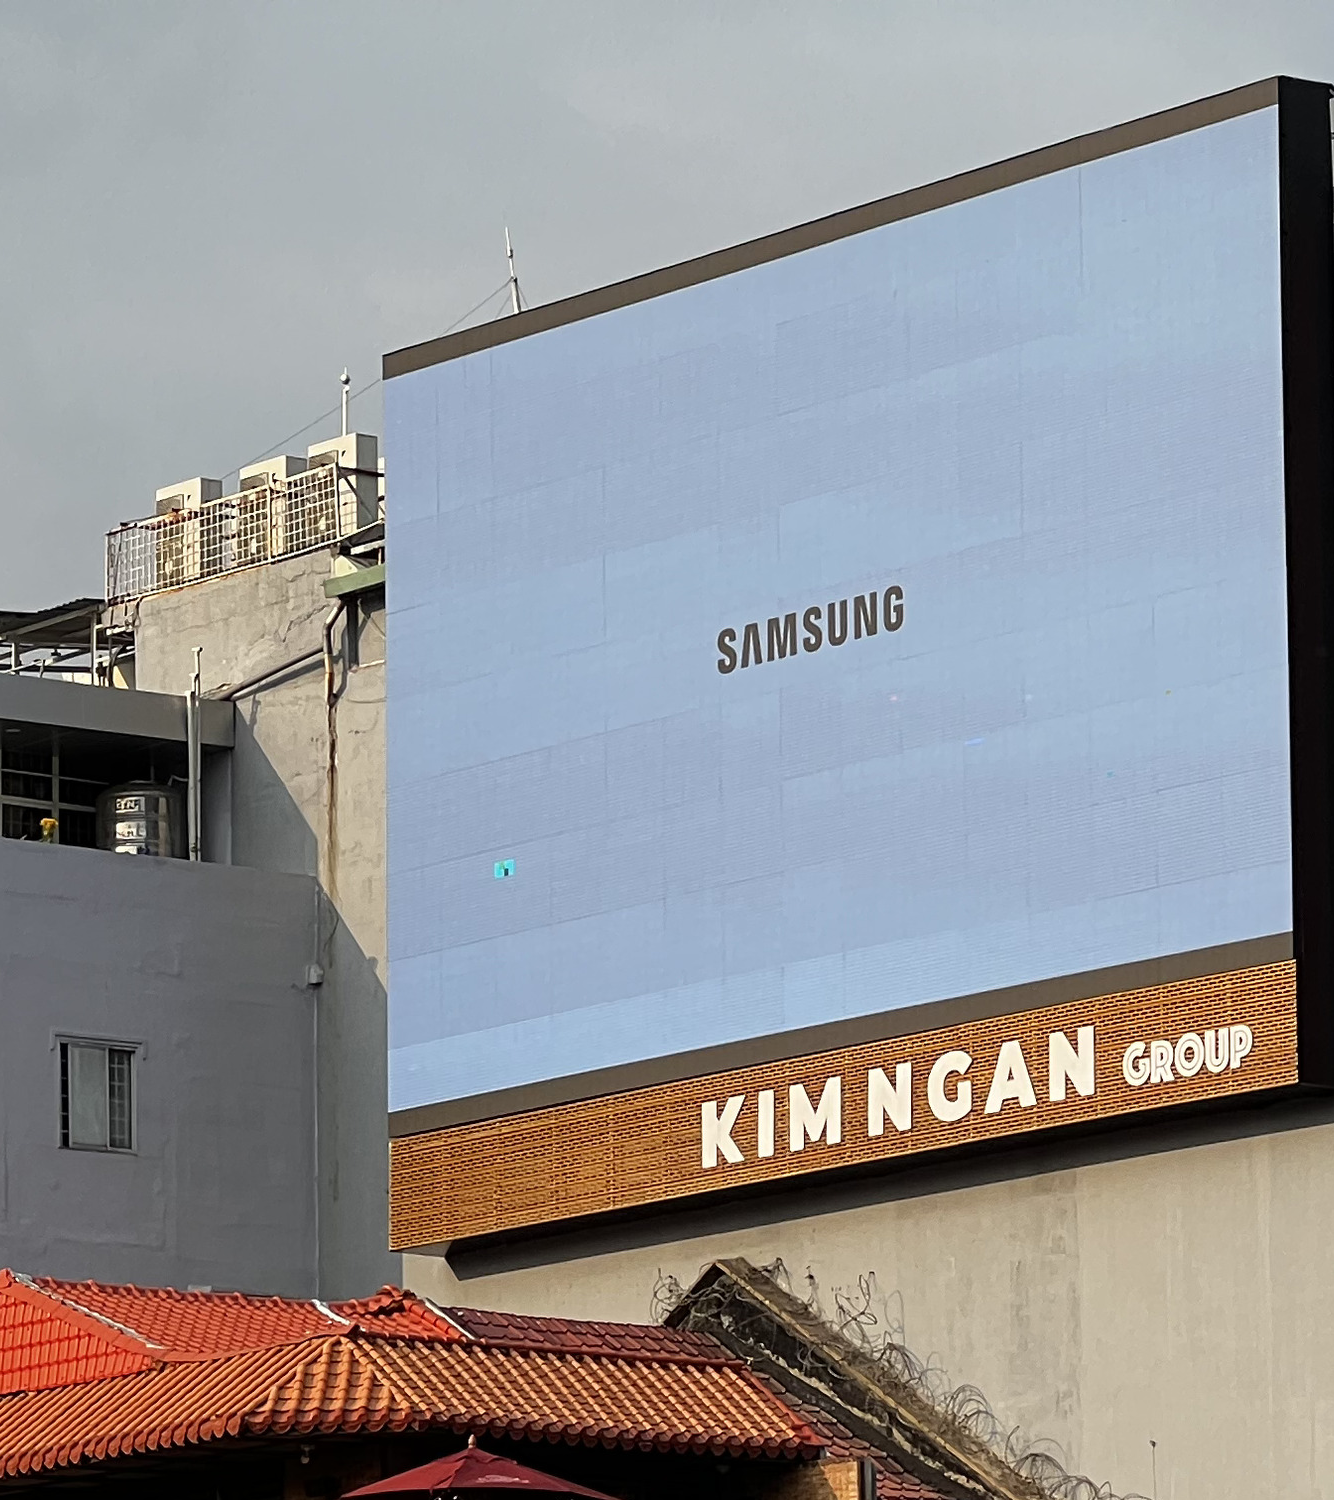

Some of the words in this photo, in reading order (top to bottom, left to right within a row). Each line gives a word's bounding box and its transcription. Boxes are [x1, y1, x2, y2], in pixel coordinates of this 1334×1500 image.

[717, 585, 905, 674] SAMSUNG
[700, 1075, 843, 1169] KIM
[867, 1025, 1097, 1138] NGAN
[1123, 1024, 1254, 1088] GROUP
